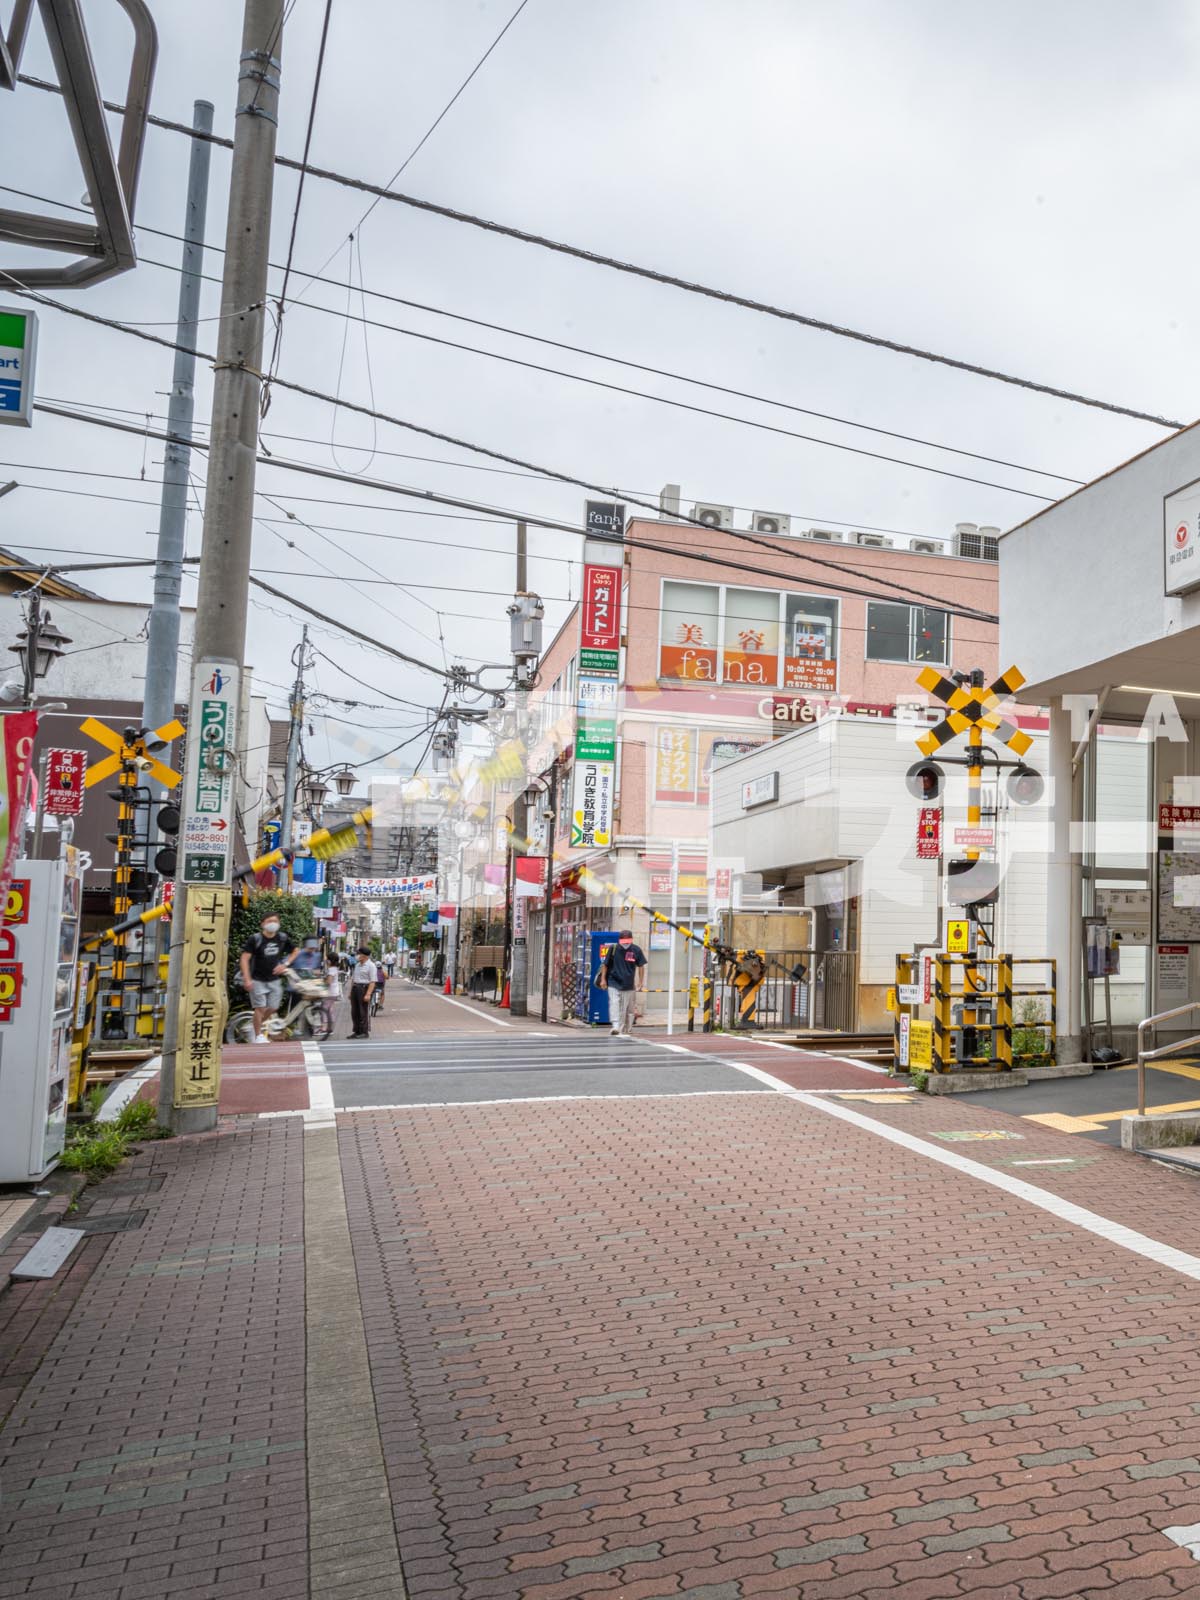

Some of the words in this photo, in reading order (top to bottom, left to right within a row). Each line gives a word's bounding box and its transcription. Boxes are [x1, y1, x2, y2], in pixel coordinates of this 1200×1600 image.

[594, 587, 610, 633] ガスト
[593, 638, 609, 646] 2F
[680, 650, 768, 685] fana
[786, 664, 805, 674] 10:00
[815, 667, 834, 676] 20:00
[580, 681, 615, 703] 歯科
[757, 697, 817, 723] Café
[55, 765, 78, 773] STOP
[49, 788, 80, 798] 非常停止
[52, 796, 76, 804] ボタン
[582, 764, 597, 845] うのき教育学院
[1161, 807, 1200, 818] 危険物品
[184, 833, 229, 843] 5482-8931
[193, 870, 216, 878] 2-5
[193, 928, 216, 988] この先
[190, 999, 215, 1082] 左折禁止
